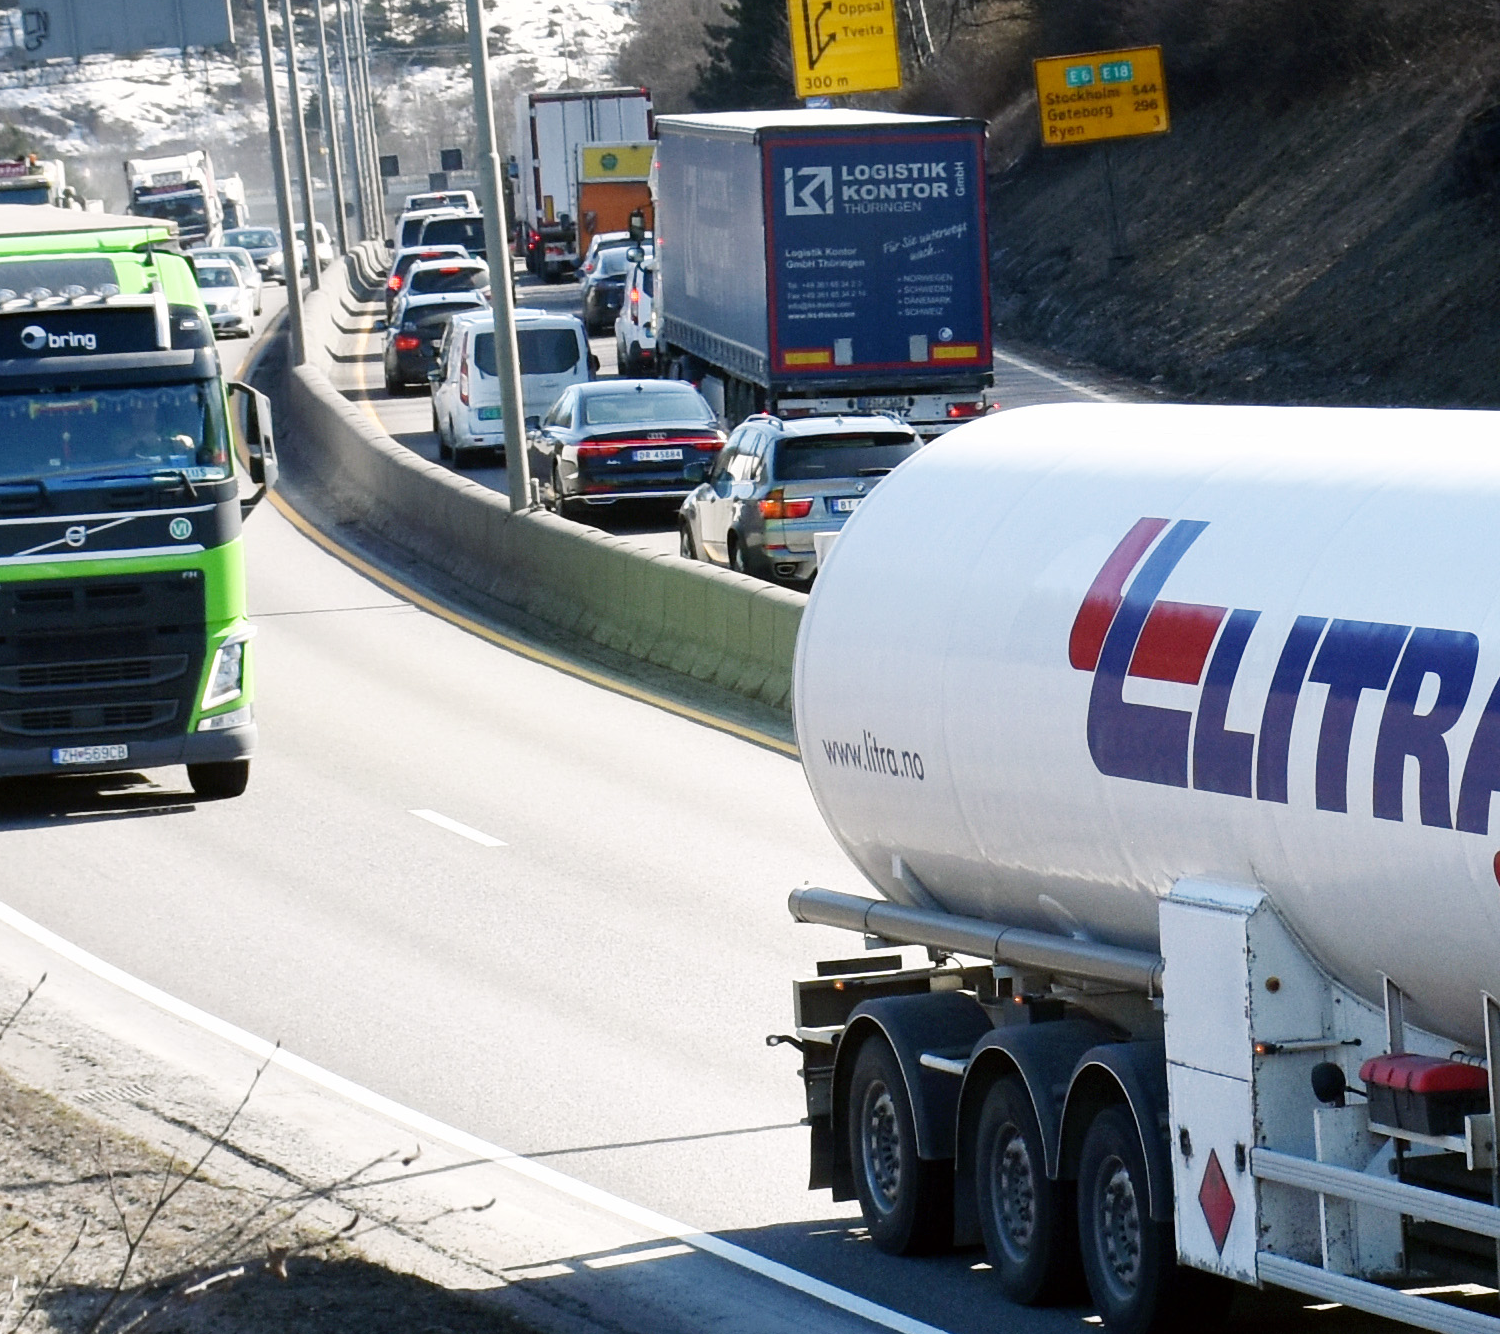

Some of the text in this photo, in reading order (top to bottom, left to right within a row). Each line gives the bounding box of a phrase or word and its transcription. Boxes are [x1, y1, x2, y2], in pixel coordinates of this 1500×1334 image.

[838, 0, 885, 15] Oppsal
[841, 25, 884, 37] Tveita
[805, 76, 849, 89] 300 m
[1046, 86, 1120, 105] Stockholm
[1049, 125, 1085, 140] Ryen
[841, 162, 947, 180] LOGISTIK
[954, 161, 966, 197] GmbH
[842, 182, 949, 200] KONTOR
[843, 201, 922, 214] THÜRINGEN
[785, 248, 857, 259] Logistik Kontor
[786, 260, 815, 269] GmbH
[48, 331, 97, 350] bring
[821, 729, 925, 780] www.litra.no
